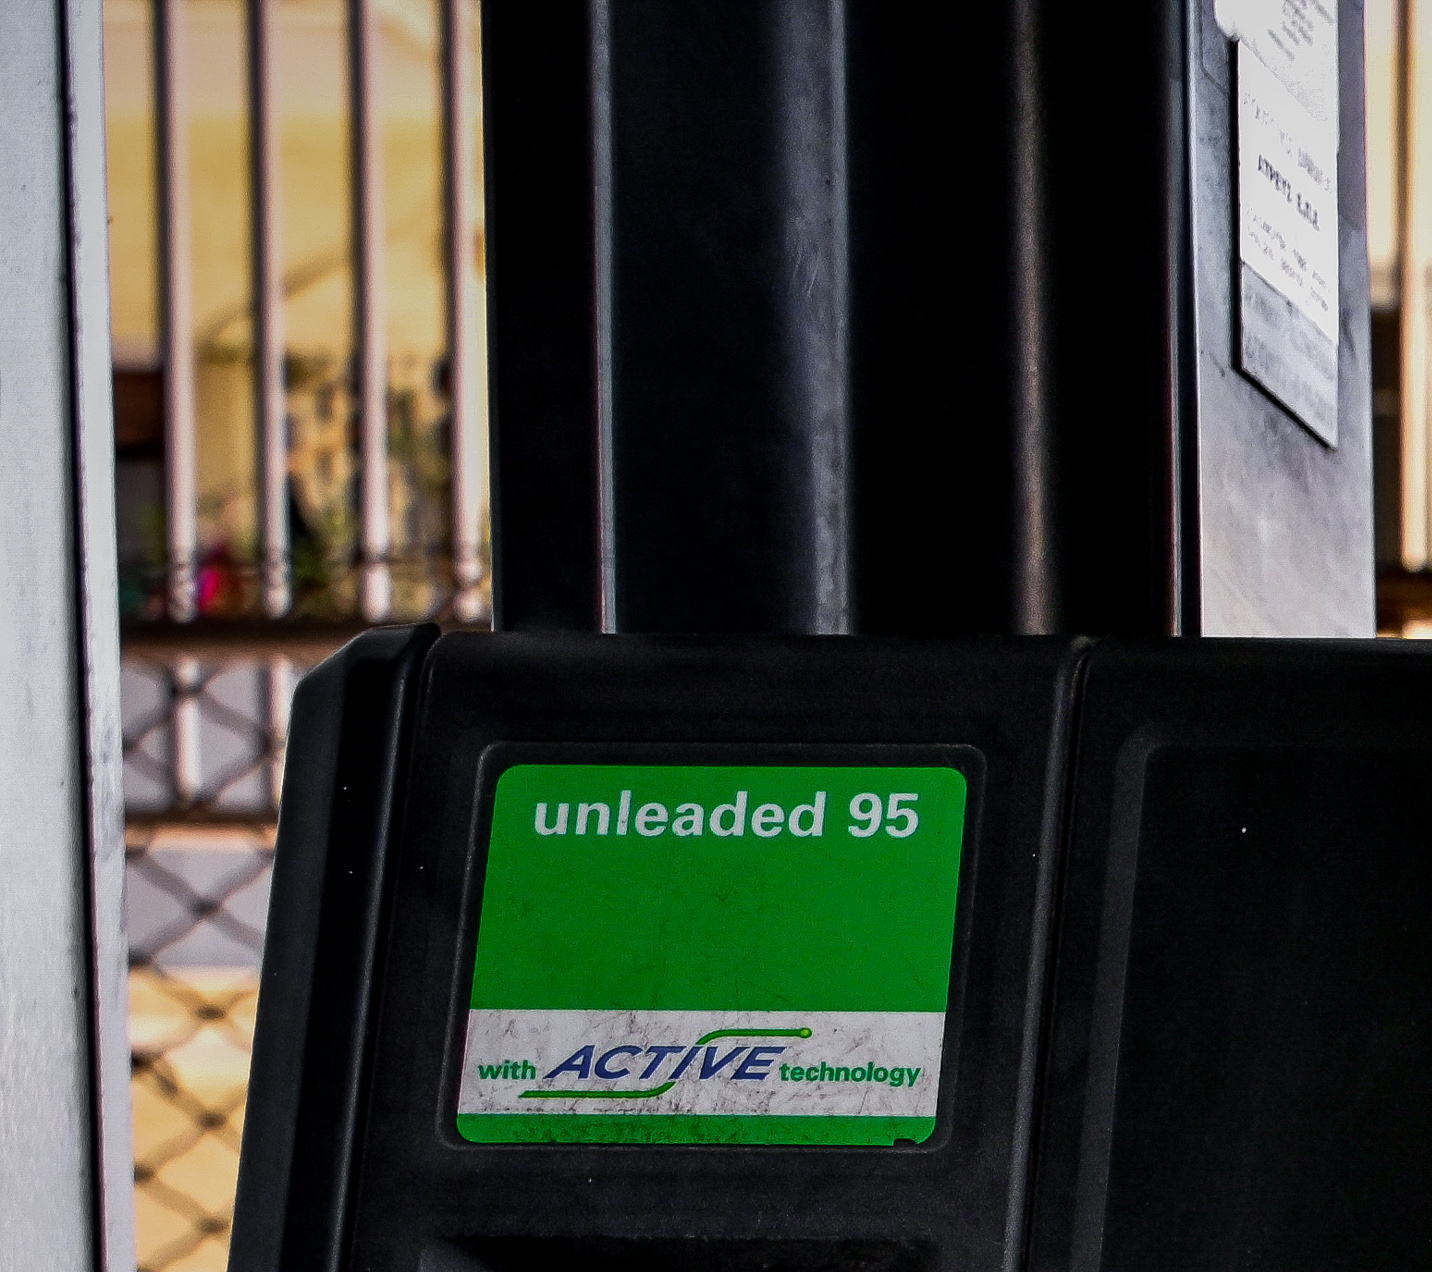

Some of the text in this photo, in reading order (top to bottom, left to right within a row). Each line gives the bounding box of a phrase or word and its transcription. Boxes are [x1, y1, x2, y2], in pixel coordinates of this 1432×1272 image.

[534, 789, 920, 839] unleaded 95
[478, 1045, 921, 1087] with ACTIVE technology
